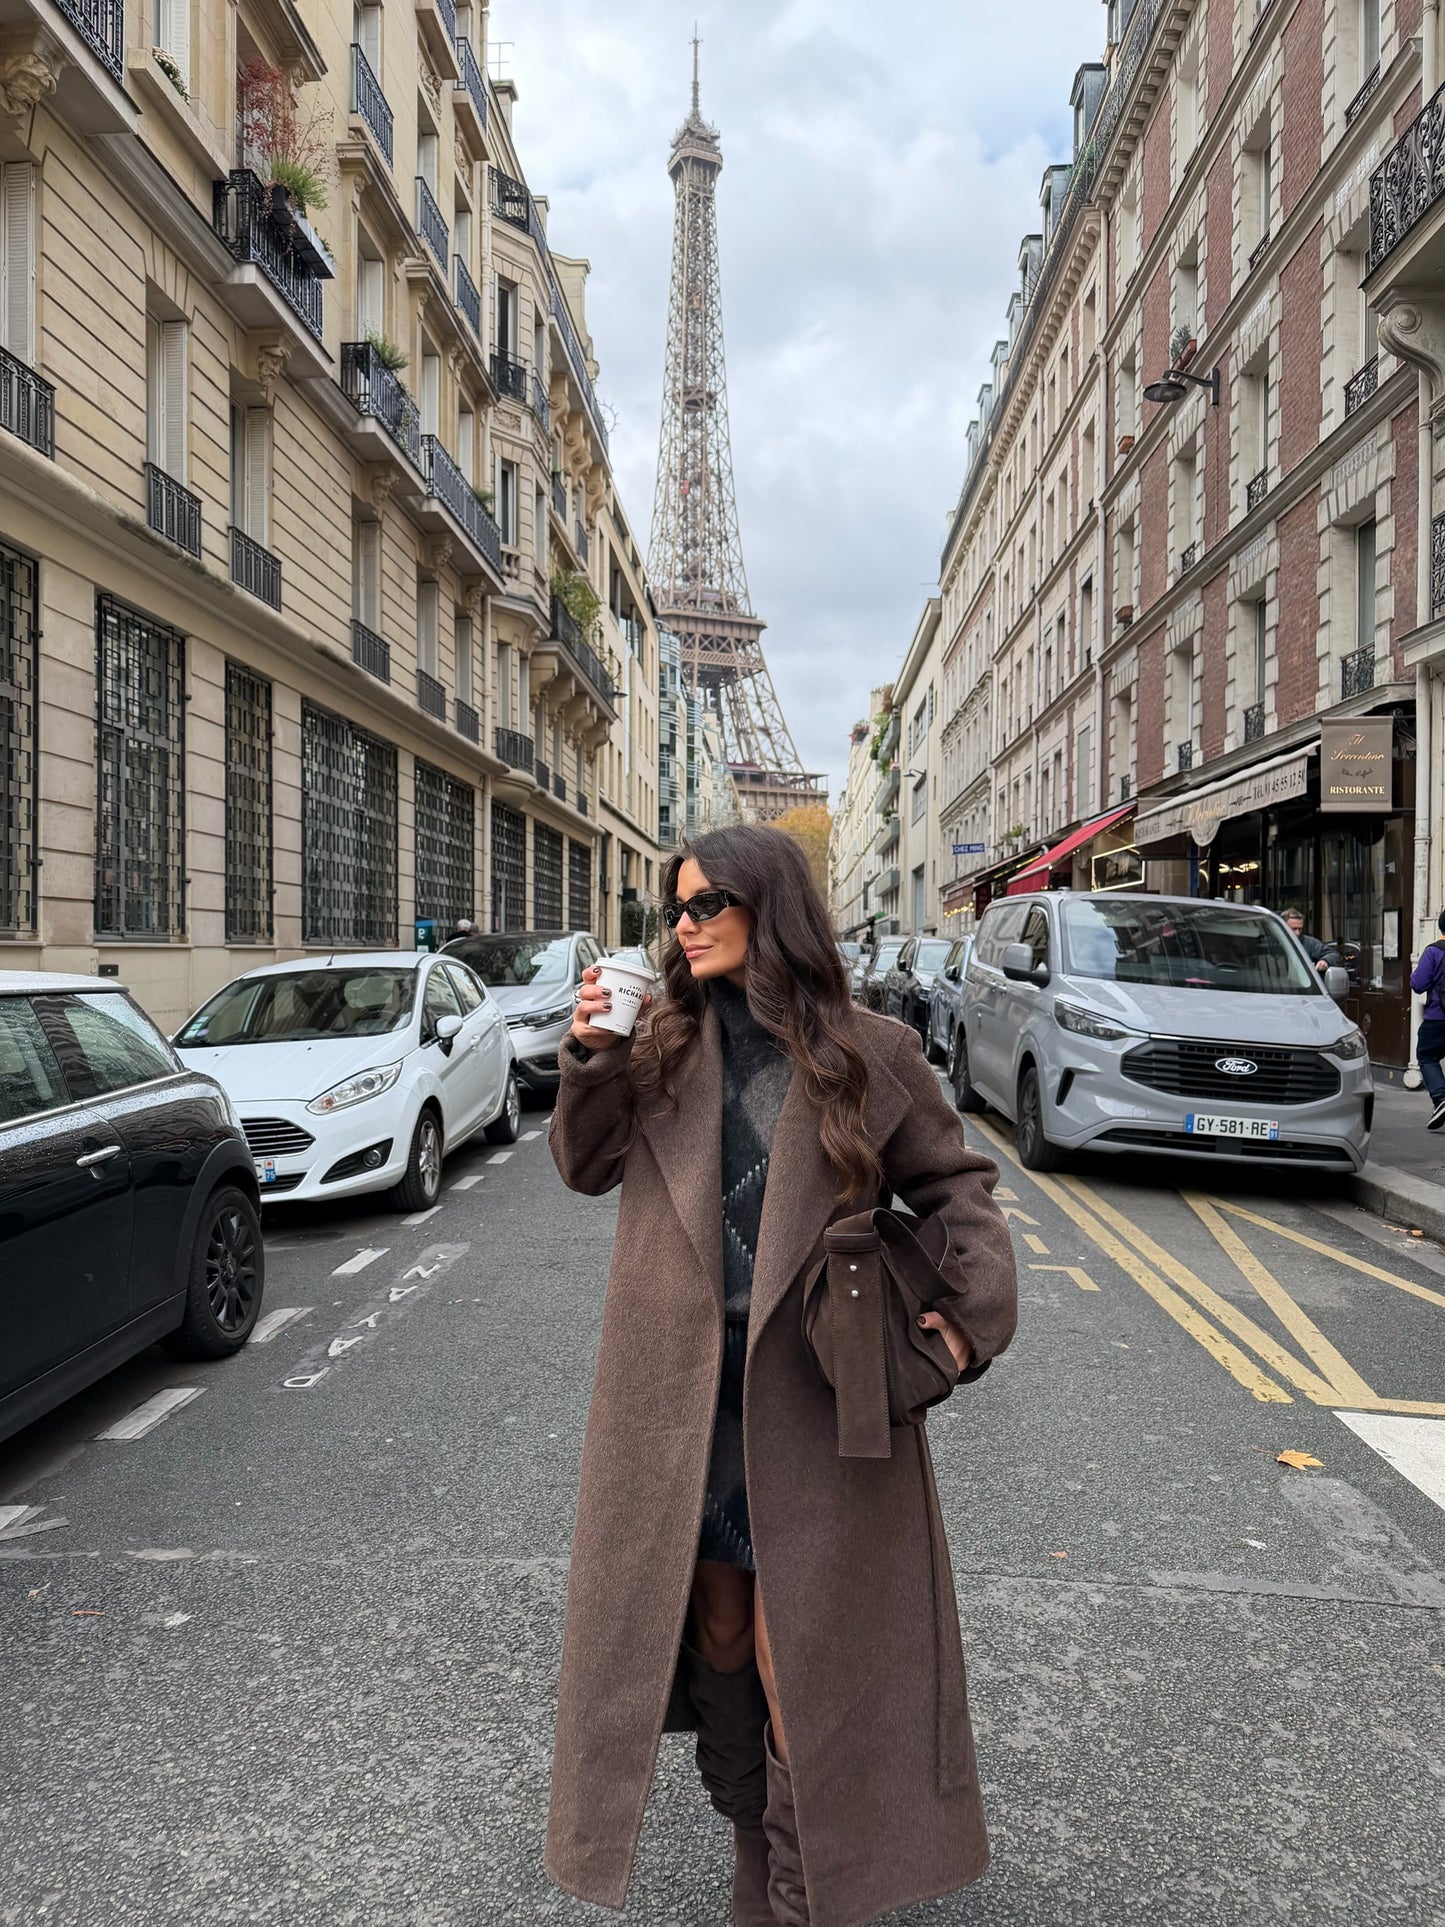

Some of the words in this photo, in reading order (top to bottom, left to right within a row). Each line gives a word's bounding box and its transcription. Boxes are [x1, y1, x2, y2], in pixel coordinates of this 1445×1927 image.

[1330, 786, 1385, 794] RISTORANTE
[1222, 1059, 1250, 1072] Ford
[1270, 1129, 1278, 1138] 91
[265, 1171, 276, 1179] 75
